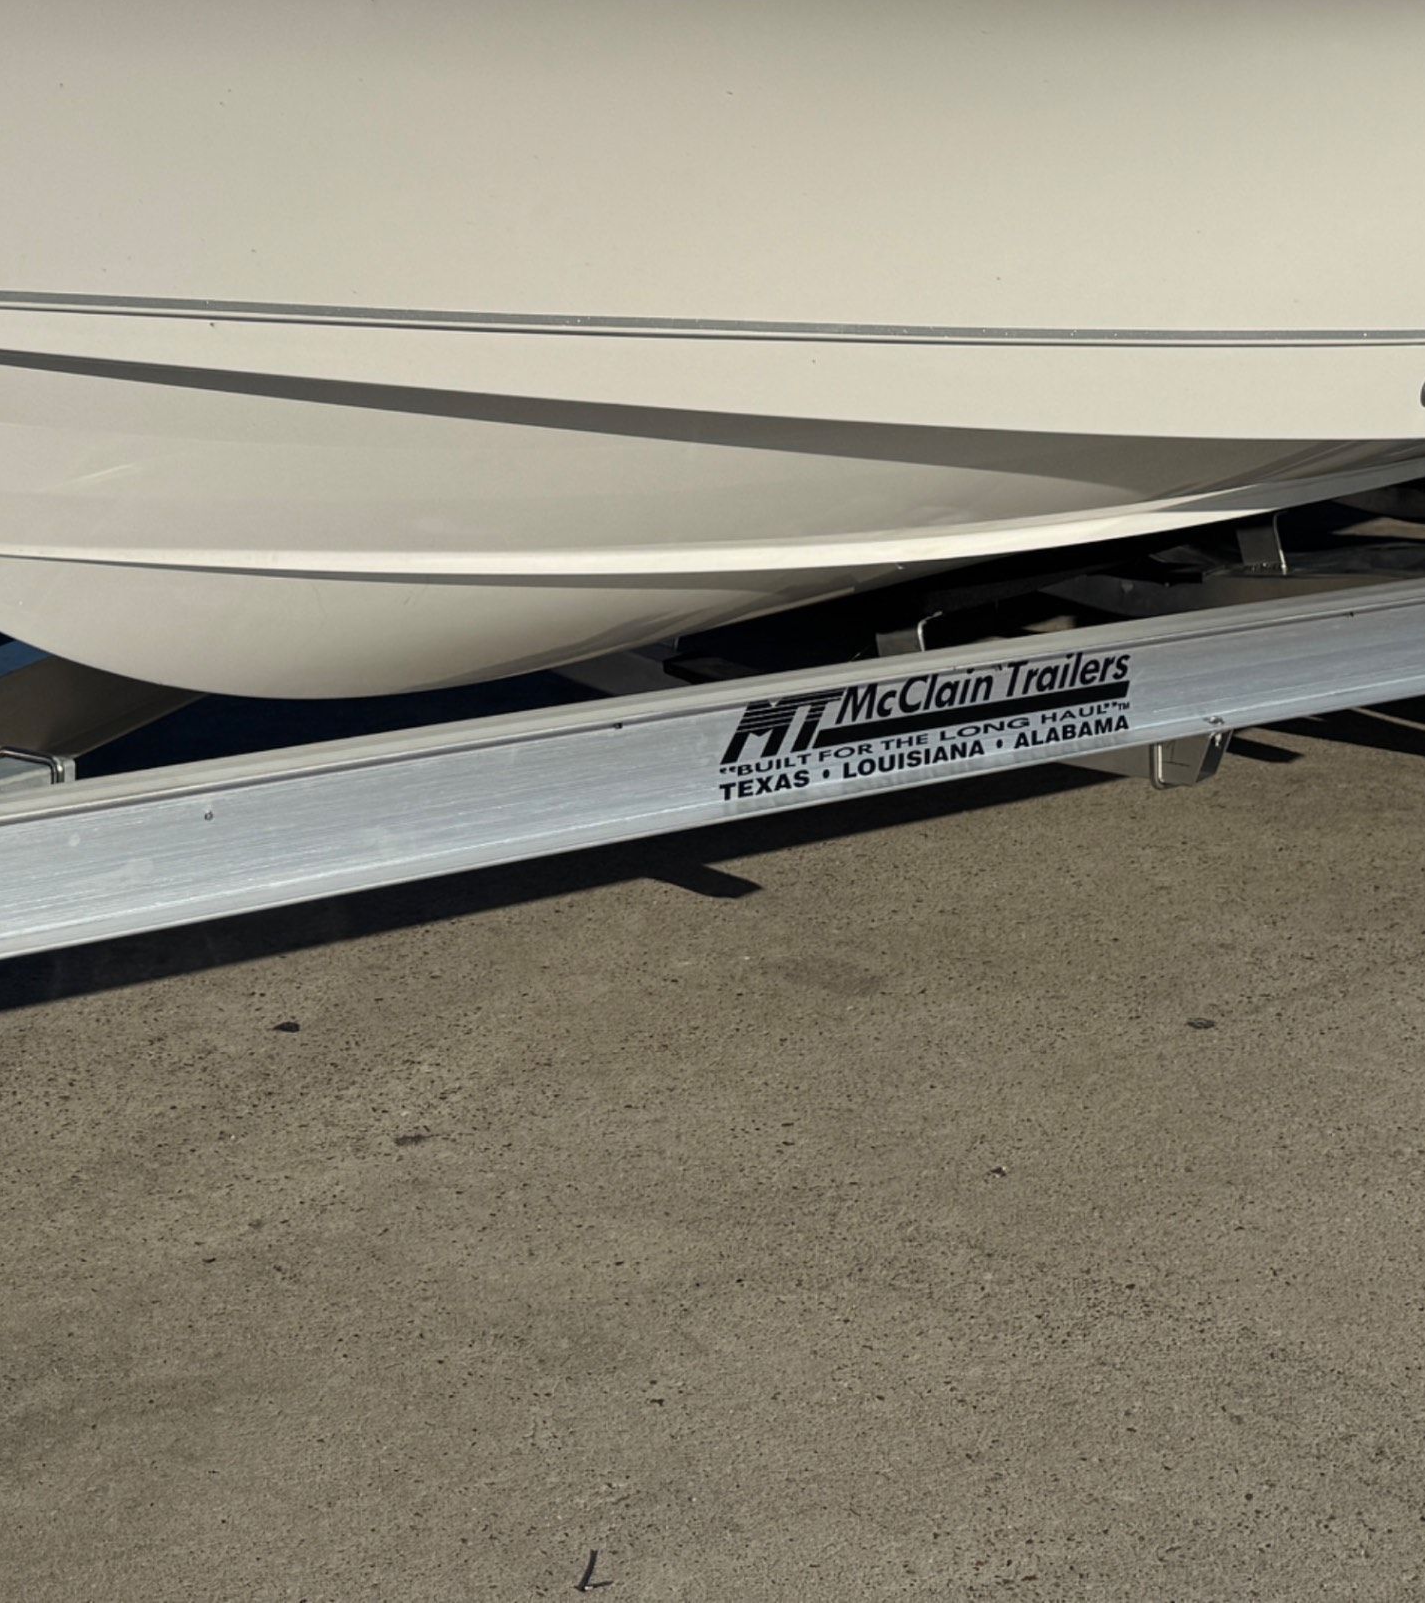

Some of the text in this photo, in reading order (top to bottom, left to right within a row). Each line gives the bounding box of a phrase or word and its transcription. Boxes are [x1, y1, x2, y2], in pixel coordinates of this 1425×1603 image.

[835, 668, 994, 725] McClain
[1006, 652, 1130, 697] Trailers
[719, 715, 1129, 800] TEXAS LOUISIANA ALABAMA
[819, 743, 873, 762] FOR
[881, 733, 929, 750] THE
[940, 718, 1030, 741] LONG
